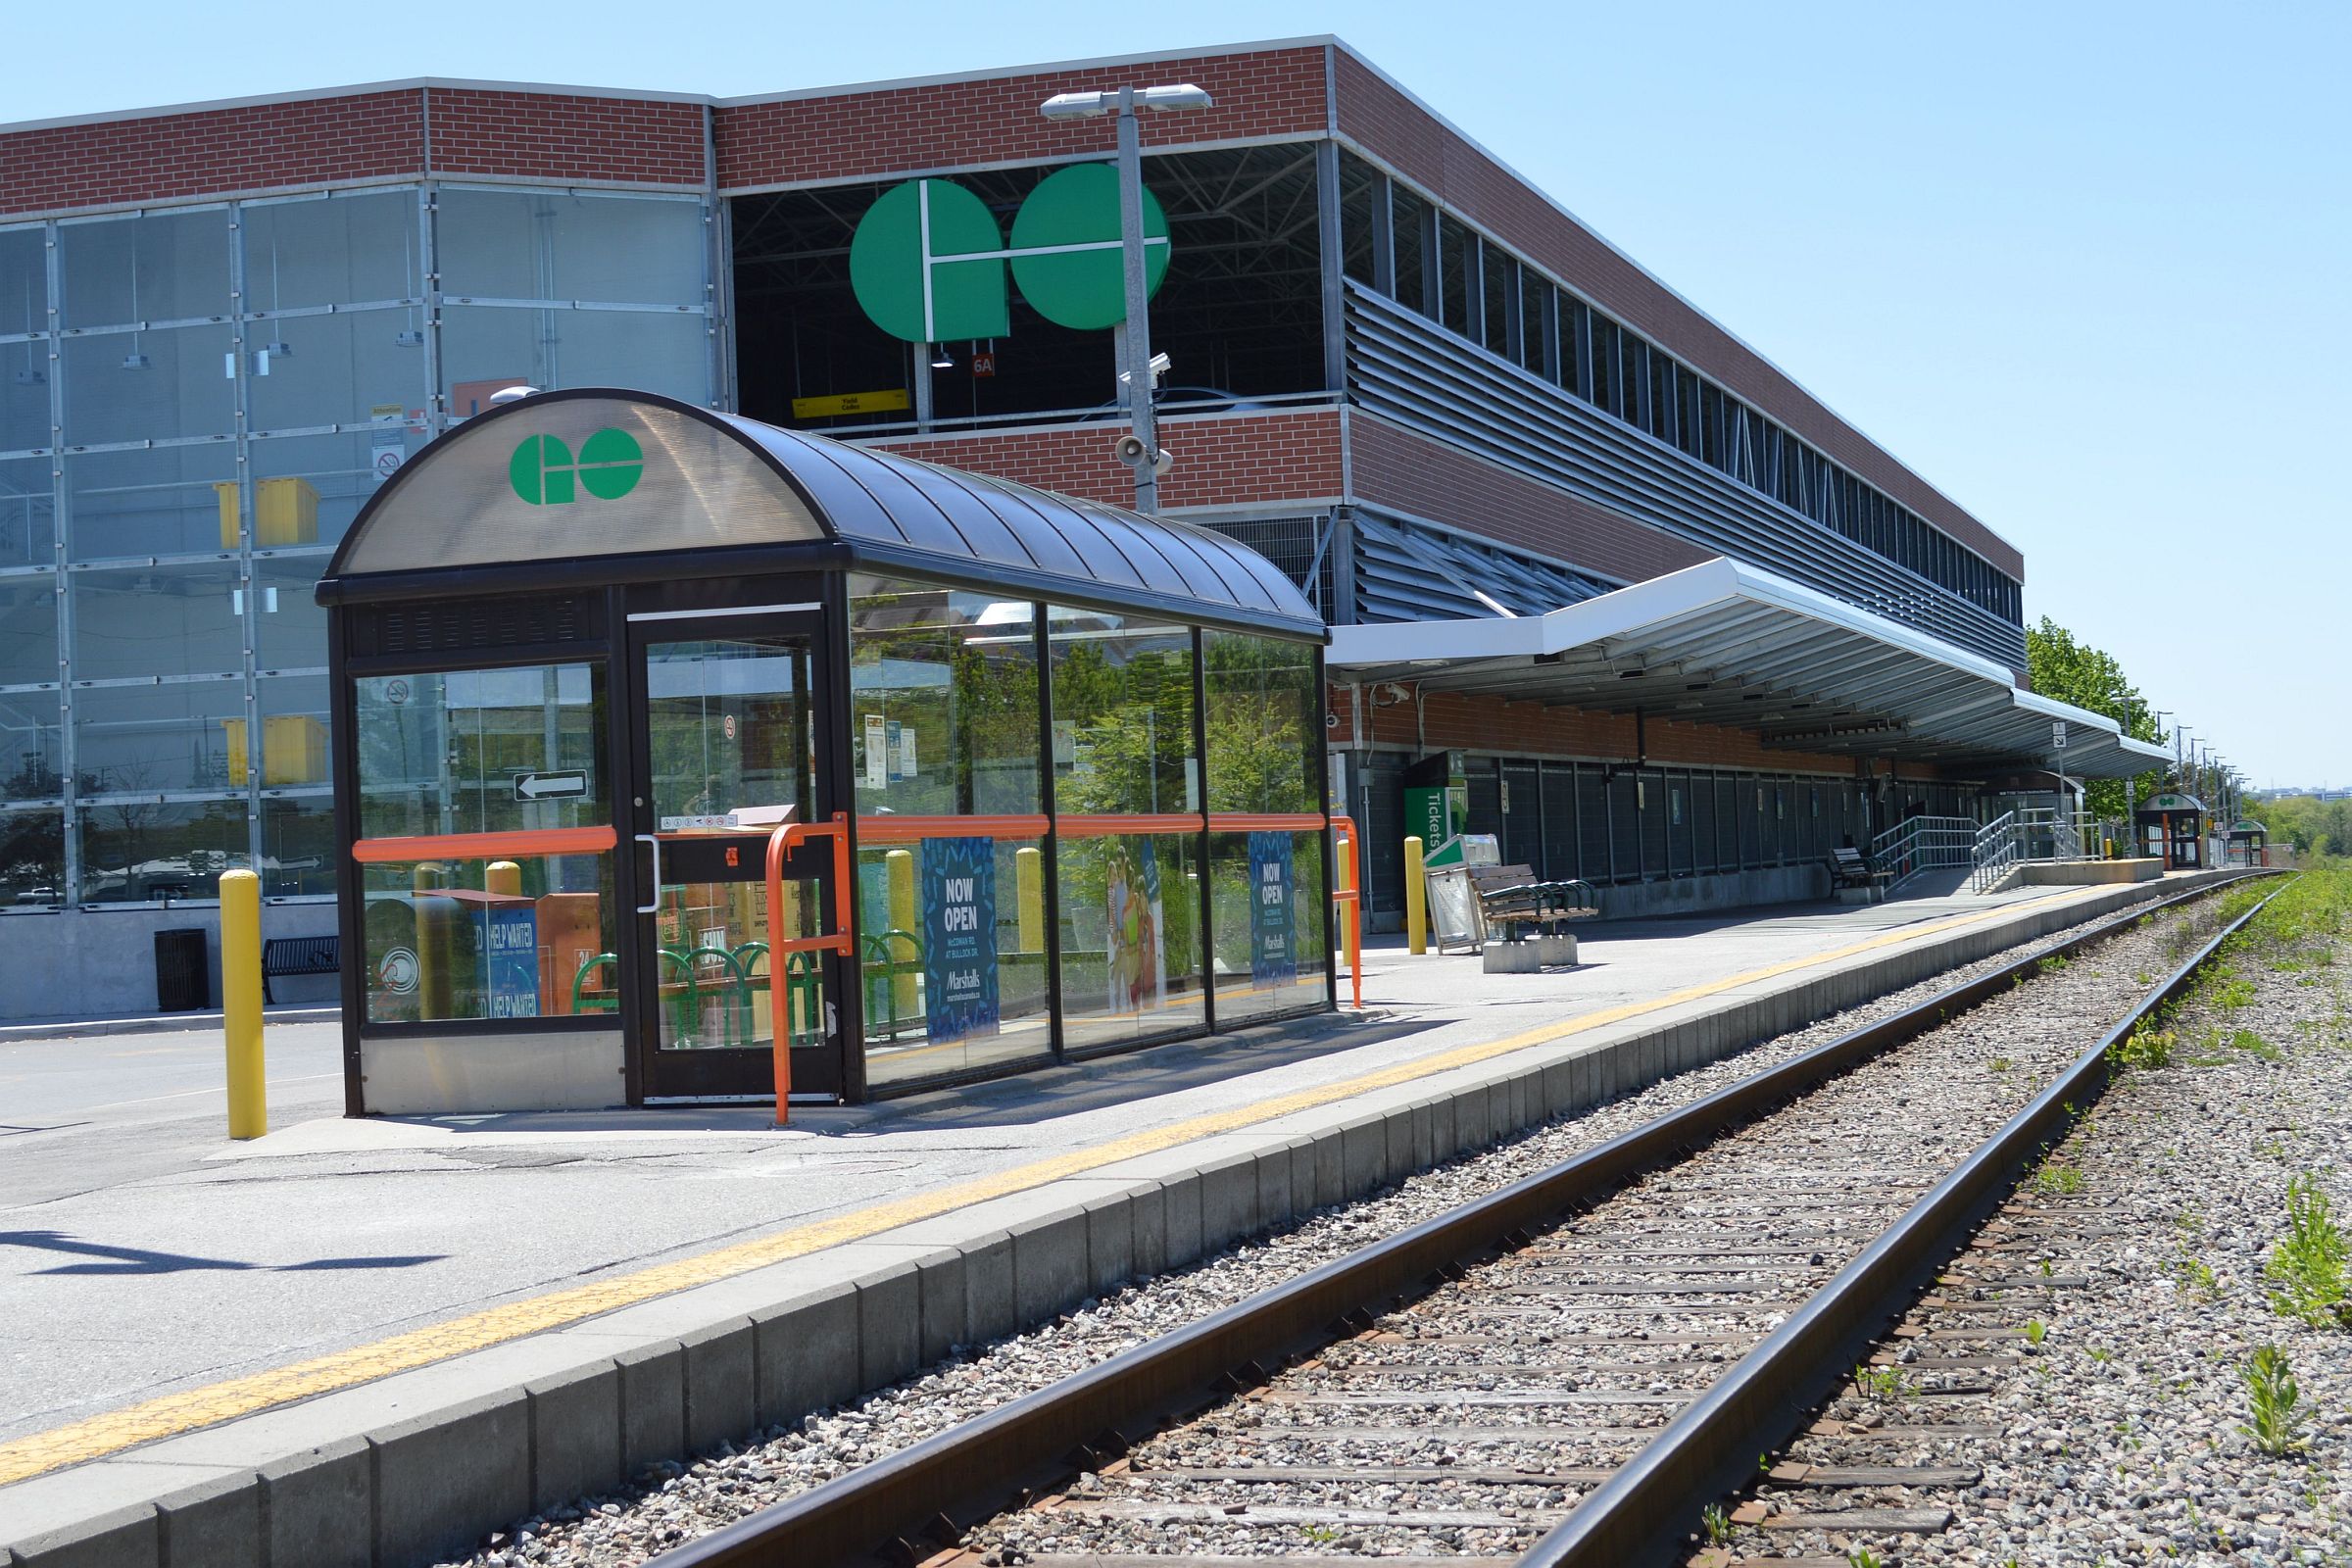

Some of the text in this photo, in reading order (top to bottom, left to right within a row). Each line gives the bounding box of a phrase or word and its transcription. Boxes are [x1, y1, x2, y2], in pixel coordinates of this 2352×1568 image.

[850, 161, 1172, 344] GO
[972, 358, 993, 373] 6A
[510, 427, 643, 506] GO
[1428, 792, 1443, 847] Tickets
[1262, 862, 1281, 882] NOW
[946, 878, 974, 904] NOW
[1262, 885, 1283, 905] OPEN
[944, 906, 978, 932] OPEN
[489, 923, 506, 950] HELP
[507, 922, 533, 948] WANTED
[947, 968, 980, 991] Marshalls
[493, 994, 511, 1018] HELP
[511, 993, 537, 1017] WANTED
